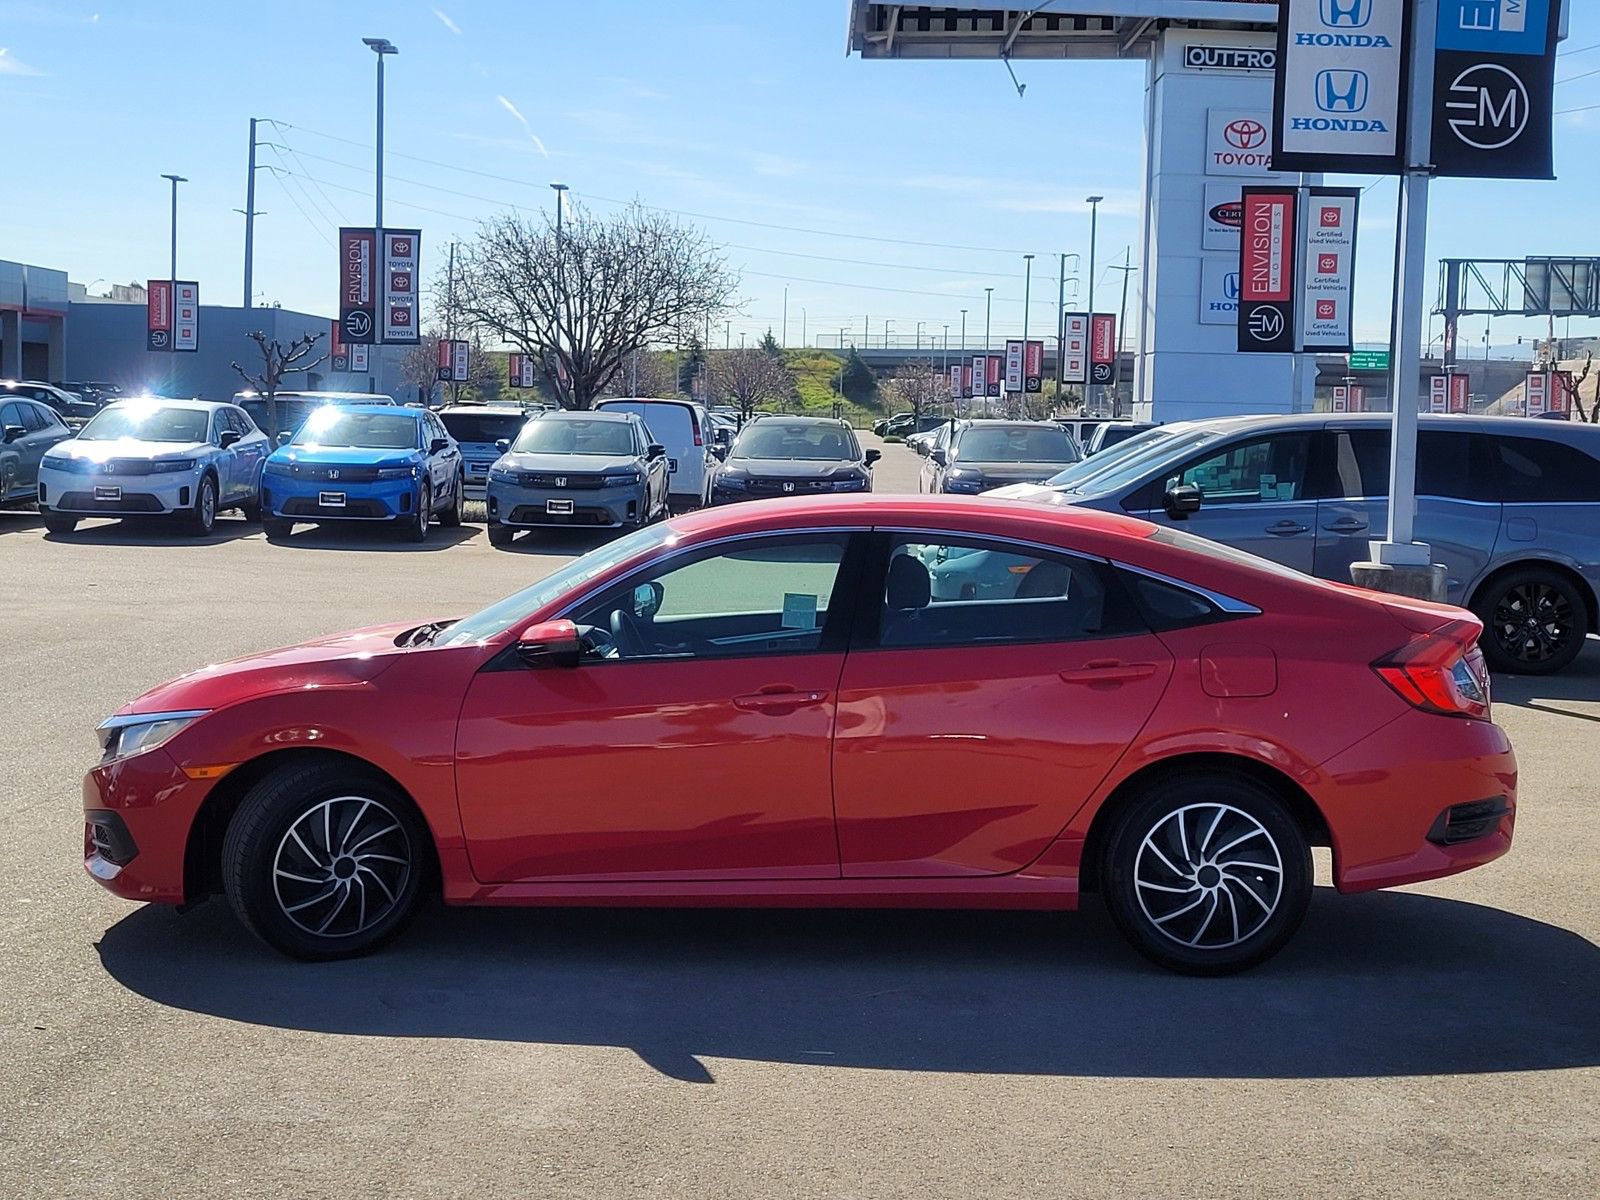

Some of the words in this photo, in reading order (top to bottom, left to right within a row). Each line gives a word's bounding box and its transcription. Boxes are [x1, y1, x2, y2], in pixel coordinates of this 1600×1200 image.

[1459, 0, 1495, 30] E
[1295, 33, 1392, 48] HONDA
[1189, 48, 1276, 68] OUTFRO
[1291, 118, 1389, 132] HONDA
[1213, 152, 1272, 167] TOYOTA
[1252, 203, 1271, 292] ENVISION
[1271, 211, 1281, 285] MOTORS
[348, 239, 361, 303] ENVISION
